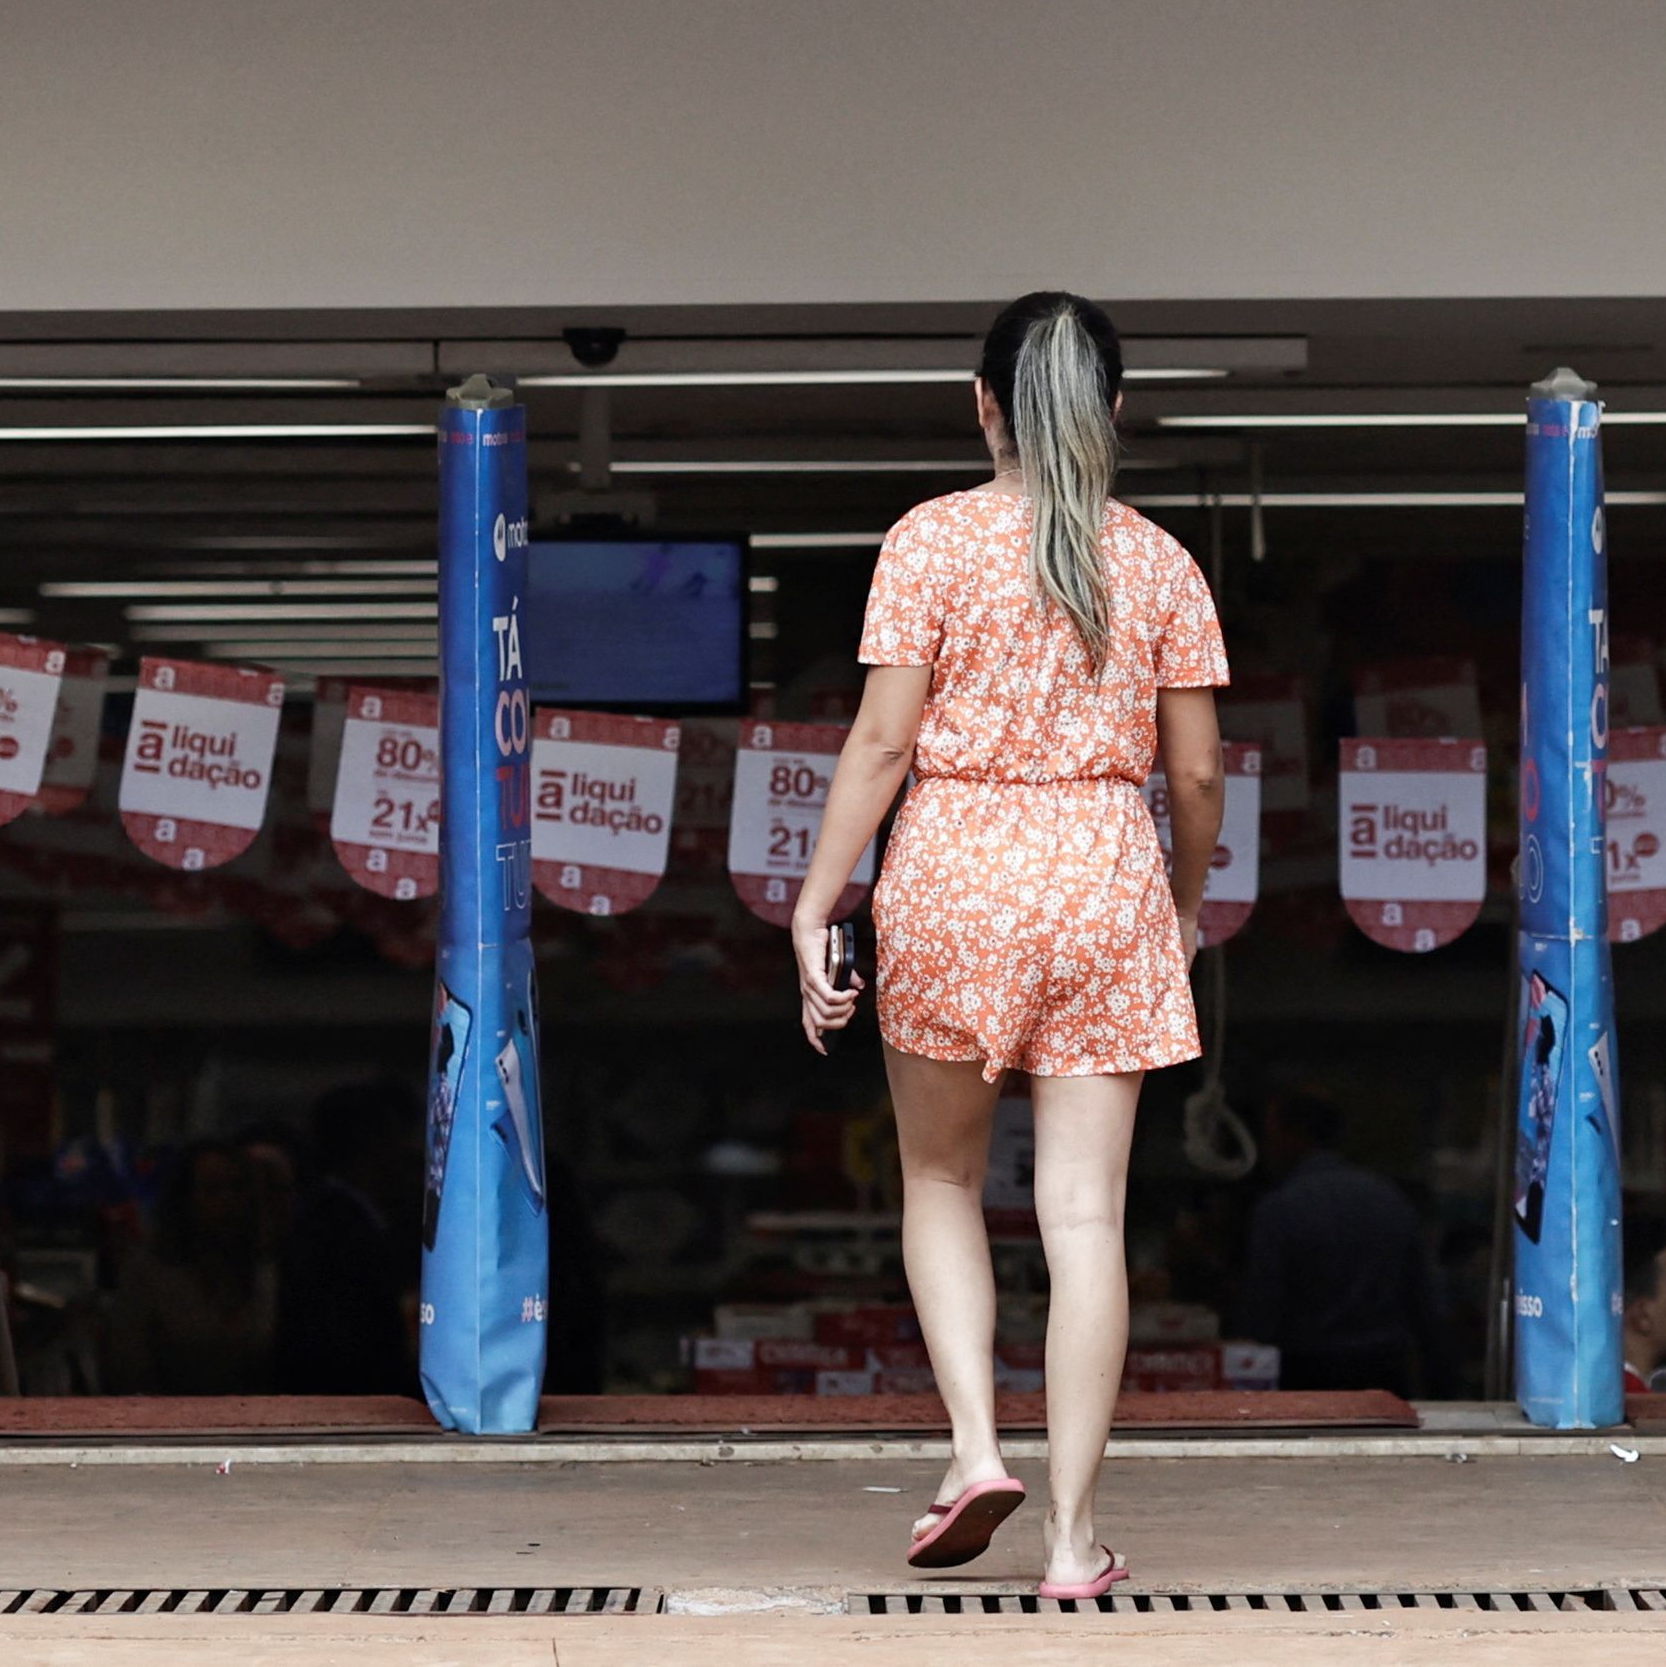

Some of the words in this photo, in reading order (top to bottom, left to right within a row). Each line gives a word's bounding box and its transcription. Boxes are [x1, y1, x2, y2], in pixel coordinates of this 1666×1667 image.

[493, 595, 523, 682] TÁ
[171, 724, 238, 759] liqui
[168, 753, 262, 790] dação
[571, 772, 638, 806] liqui
[496, 763, 530, 830] TU
[371, 797, 429, 834] 21x
[569, 801, 664, 837] dação
[1383, 803, 1449, 837] liqui
[767, 826, 817, 860] 21
[1384, 834, 1480, 869] dação
[495, 839, 531, 911] TU
